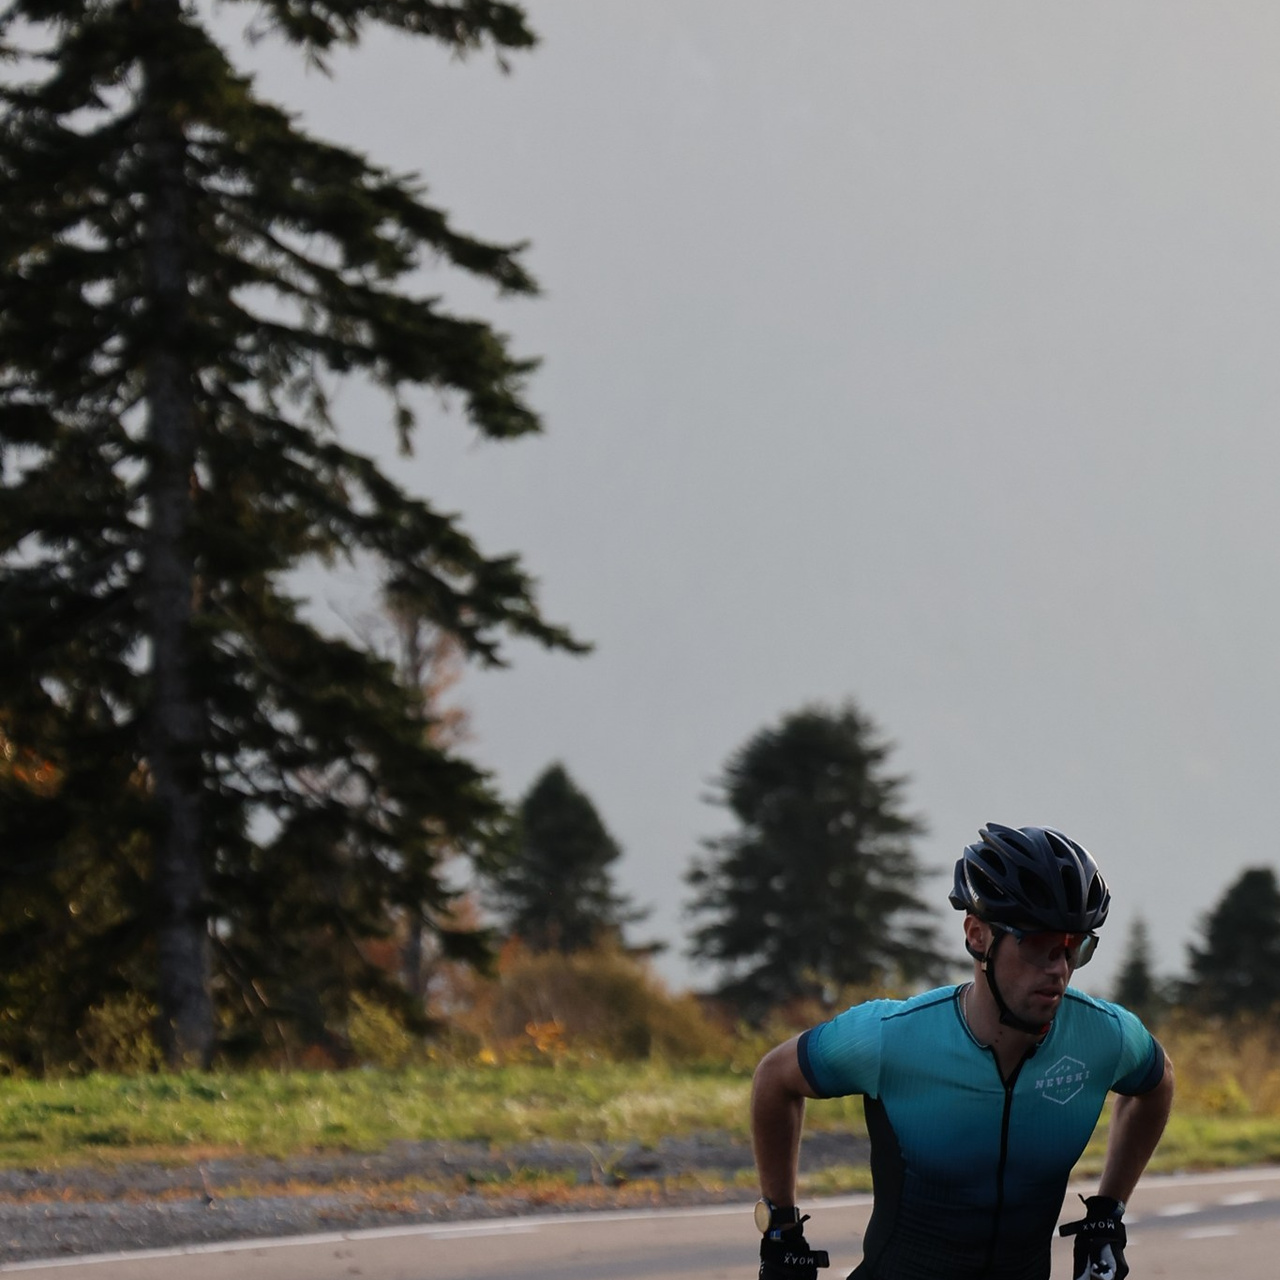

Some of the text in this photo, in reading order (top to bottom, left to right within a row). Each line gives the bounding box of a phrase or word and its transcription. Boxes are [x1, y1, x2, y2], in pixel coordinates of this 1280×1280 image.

[1034, 1070, 1090, 1089] NEVSKI
[1082, 1221, 1115, 1230] MOAX
[784, 1255, 814, 1265] MOAX
